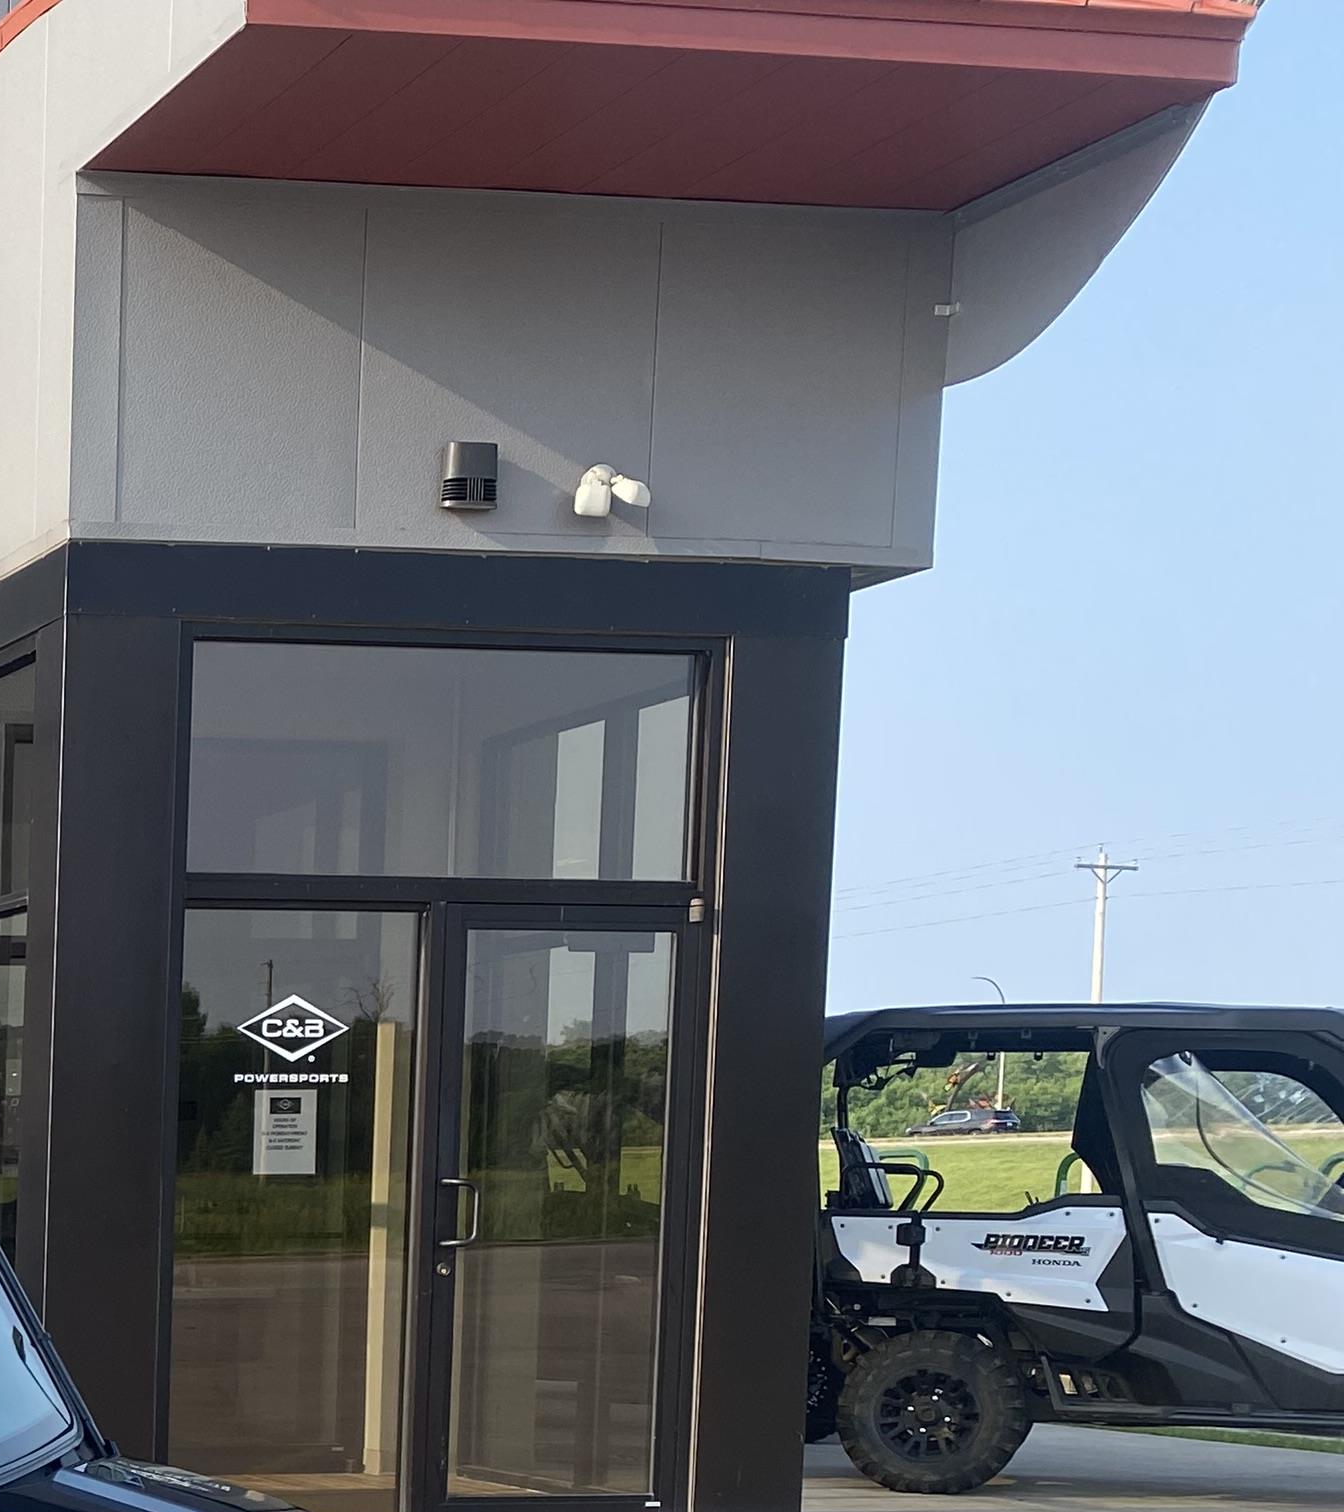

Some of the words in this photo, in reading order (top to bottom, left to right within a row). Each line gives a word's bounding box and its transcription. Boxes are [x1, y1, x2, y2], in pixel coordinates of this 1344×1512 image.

[262, 1018, 325, 1038] C&B
[234, 1073, 349, 1083] POWERSPORTS
[981, 1233, 1088, 1253] PIONEER
[1031, 1258, 1082, 1267] HONDA
